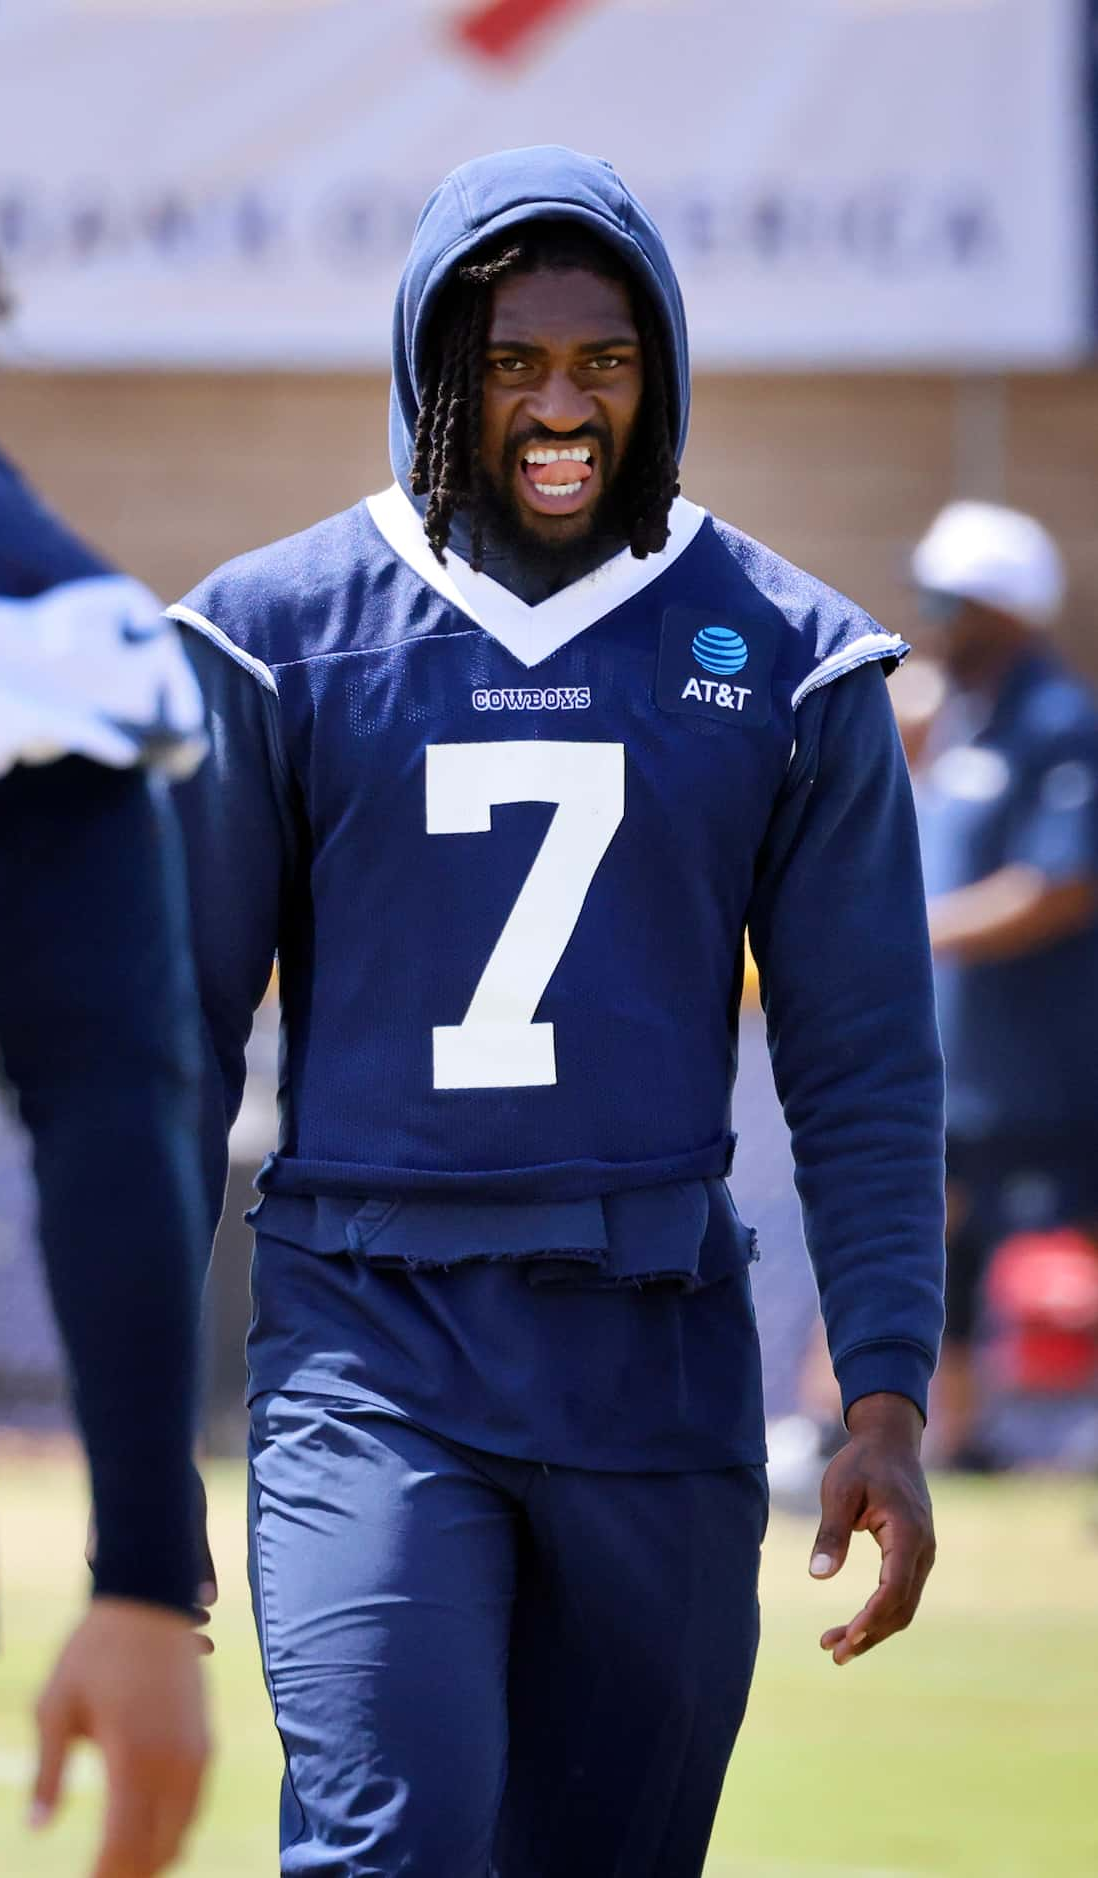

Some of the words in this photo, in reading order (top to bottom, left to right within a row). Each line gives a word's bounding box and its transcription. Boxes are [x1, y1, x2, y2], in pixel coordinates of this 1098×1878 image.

[472, 687, 591, 711] COWBOYS
[681, 677, 752, 711] AT&T
[426, 740, 625, 1090] 7
